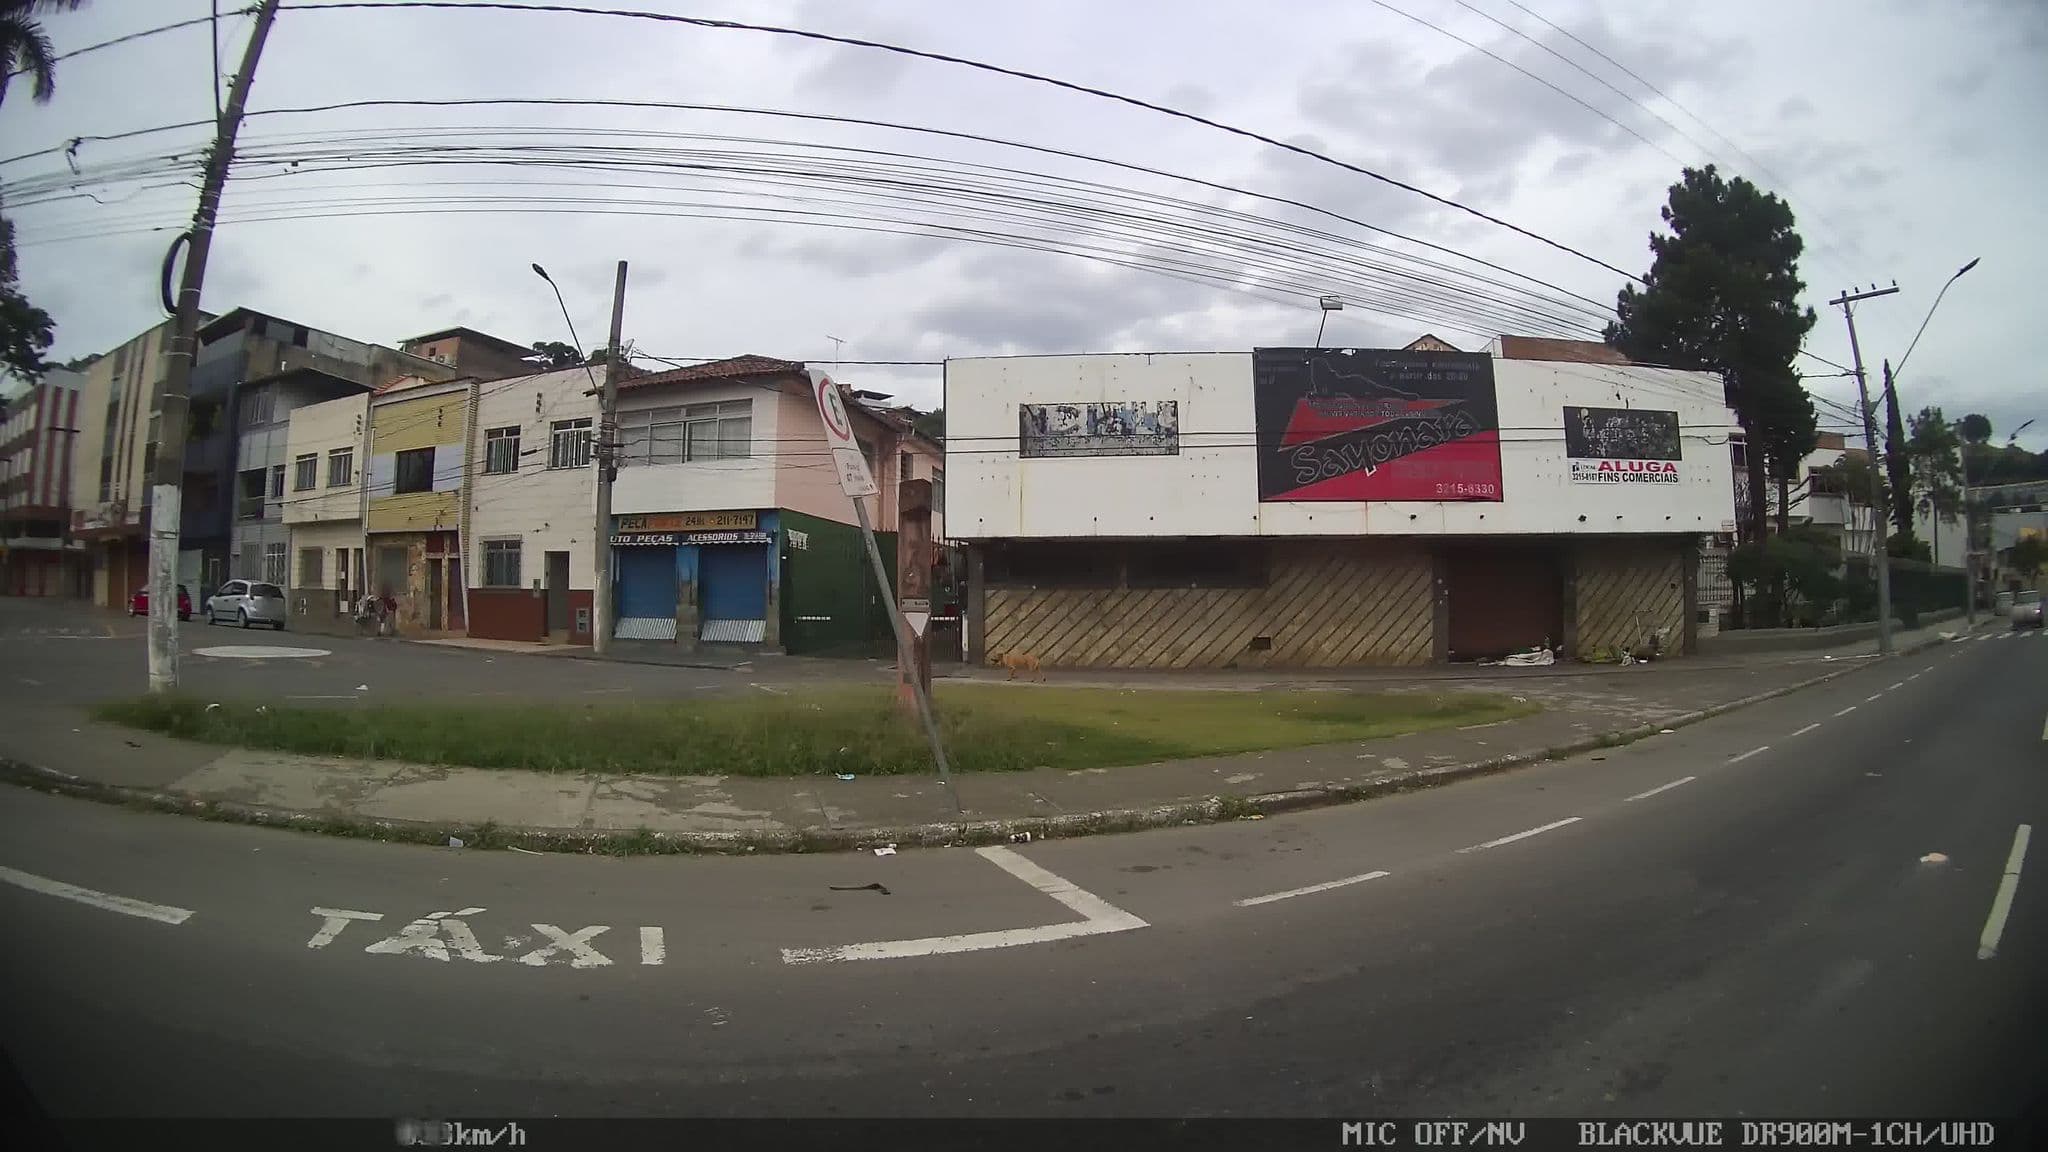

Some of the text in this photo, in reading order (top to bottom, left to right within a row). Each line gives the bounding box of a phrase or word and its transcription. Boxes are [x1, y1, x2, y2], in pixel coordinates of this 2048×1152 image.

[1598, 461, 1678, 473] ALUGA
[1598, 472, 1620, 483] FINS
[1622, 473, 1679, 483] COMERCIAIS
[636, 534, 673, 544] PEÇAS
[687, 532, 739, 542] ACESSORIOS
[307, 907, 665, 968] TÁXI
